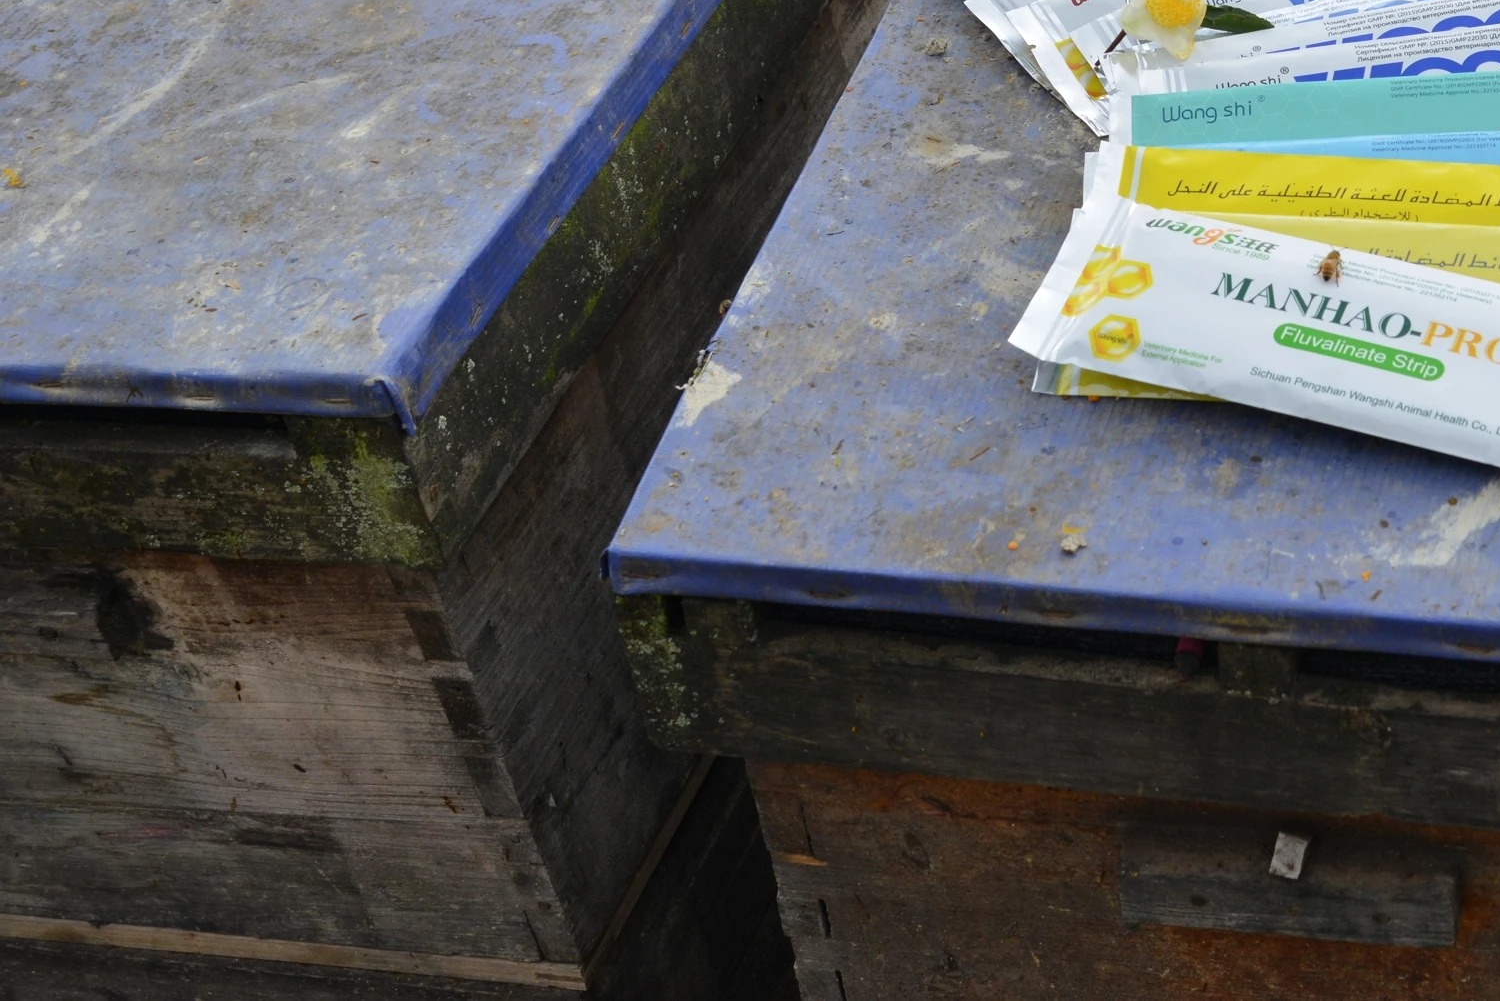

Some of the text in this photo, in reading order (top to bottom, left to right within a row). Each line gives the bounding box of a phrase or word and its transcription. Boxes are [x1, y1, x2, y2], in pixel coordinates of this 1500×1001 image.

[1357, 52, 1392, 63] Лицензия
[1403, 46, 1454, 57] производство
[1162, 101, 1252, 124] Wang shi
[1167, 180, 1218, 196] النحل
[1410, 190, 1492, 207] المضادة
[1212, 242, 1270, 261] Since 1989
[1141, 350, 1206, 369] External Application
[1144, 341, 1223, 364] Veterinary Medicine For
[1280, 326, 1438, 379] Fluvalinate Strip
[1250, 366, 1292, 384] Sichuan
[1294, 377, 1347, 398] Pengshan
[1350, 390, 1395, 409] Wangshi
[1395, 402, 1433, 418] Animal
[1434, 411, 1469, 427] Health
[1471, 420, 1492, 435] Co.,
